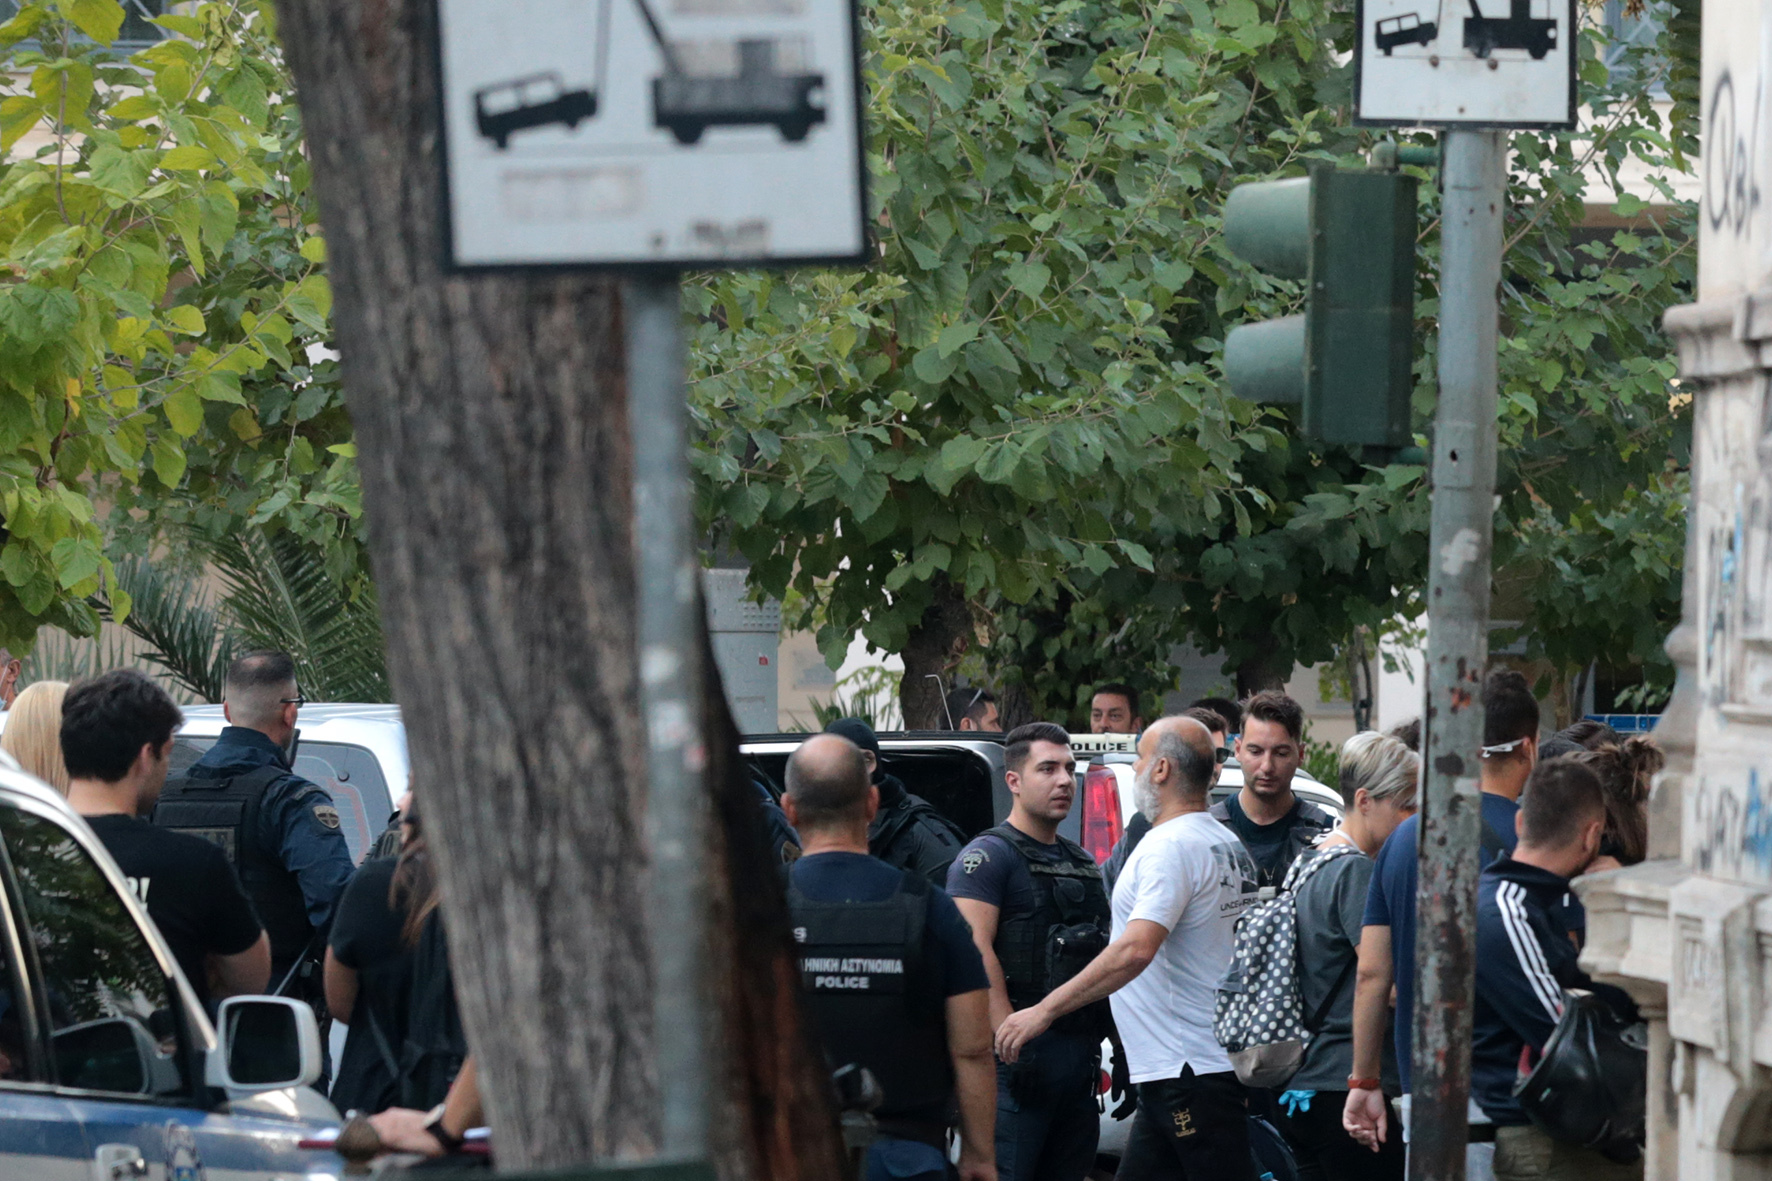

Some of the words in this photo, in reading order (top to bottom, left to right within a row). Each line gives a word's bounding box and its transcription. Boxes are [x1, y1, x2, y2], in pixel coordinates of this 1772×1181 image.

[1070, 742, 1128, 751] OLICE
[802, 957, 838, 972] ΗΝΙΚΗ
[815, 976, 870, 989] POLICE
